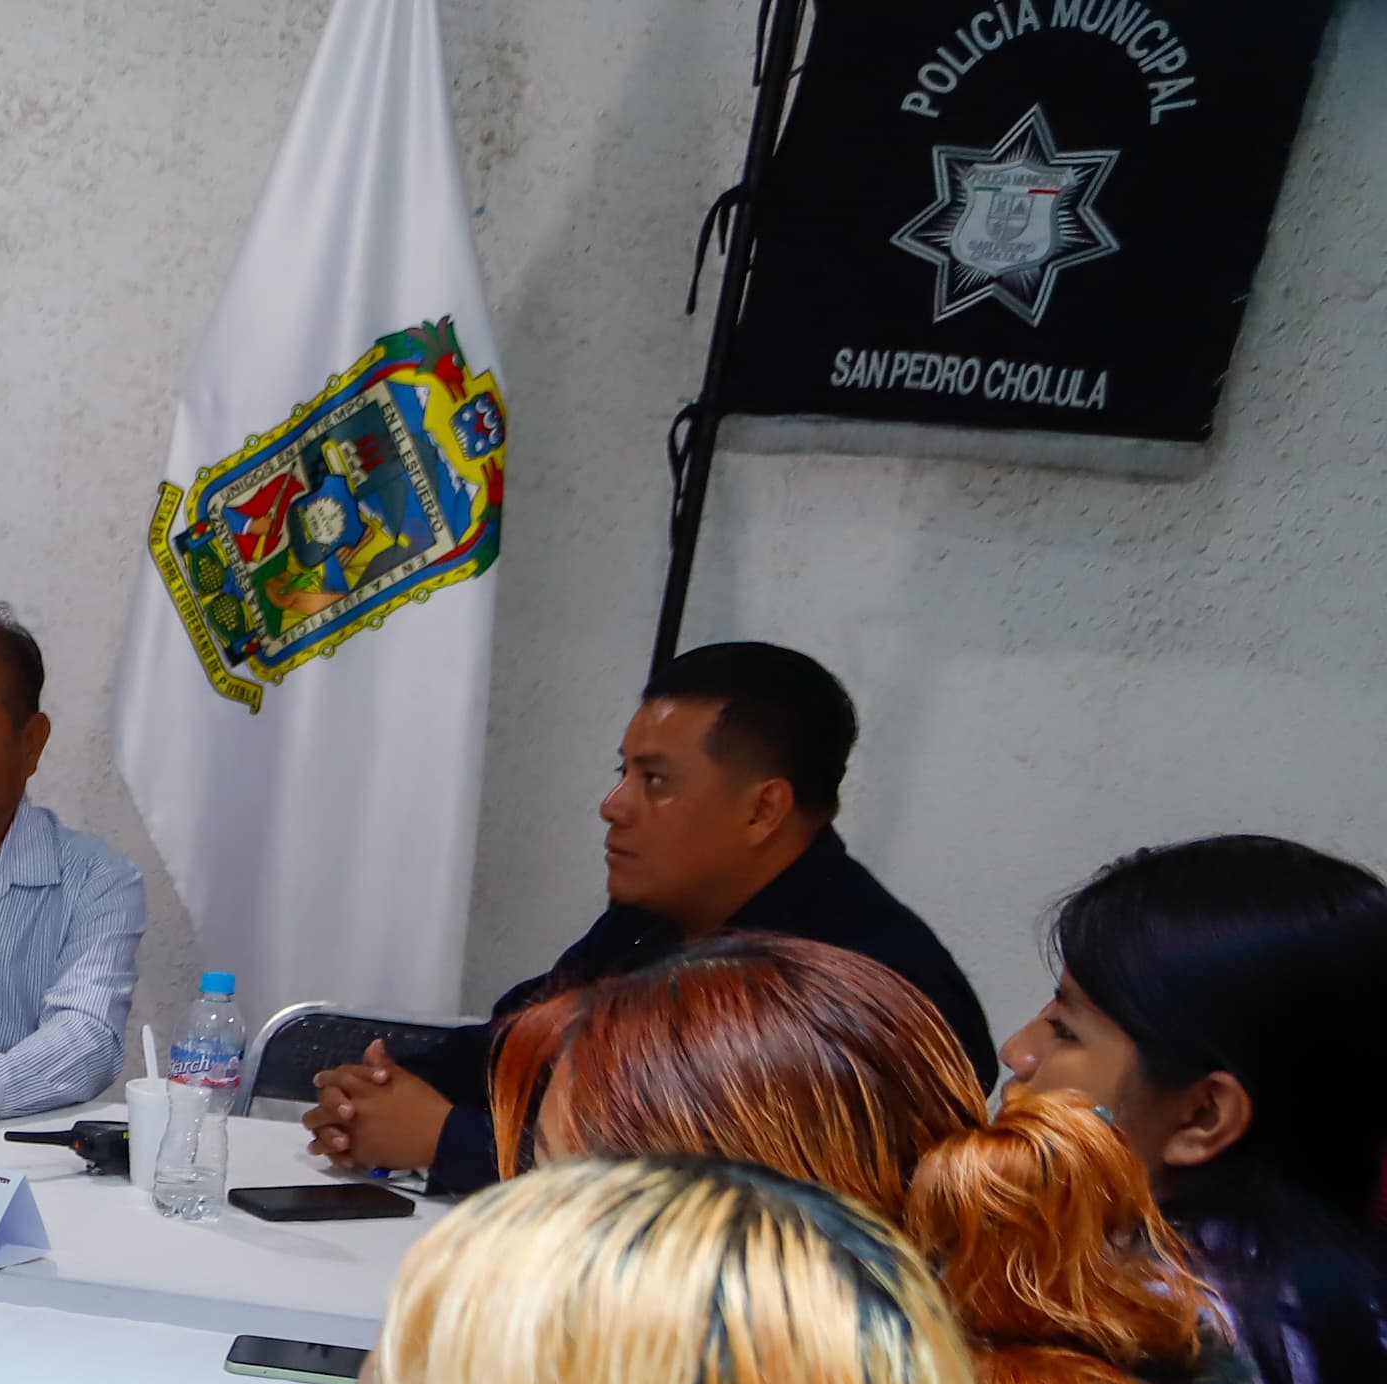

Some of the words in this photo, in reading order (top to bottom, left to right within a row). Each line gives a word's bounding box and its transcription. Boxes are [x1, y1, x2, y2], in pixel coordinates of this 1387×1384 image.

[900, 0, 1040, 118] POLICÍA
[1050, 0, 1197, 125] MUNICIPAL
[830, 347, 889, 389] SAN
[887, 351, 981, 396] PEDRO
[983, 359, 1107, 410] CHOLULA
[381, 402, 396, 427] EN
[390, 425, 406, 449] EL
[402, 448, 443, 534] ESFUERZO
